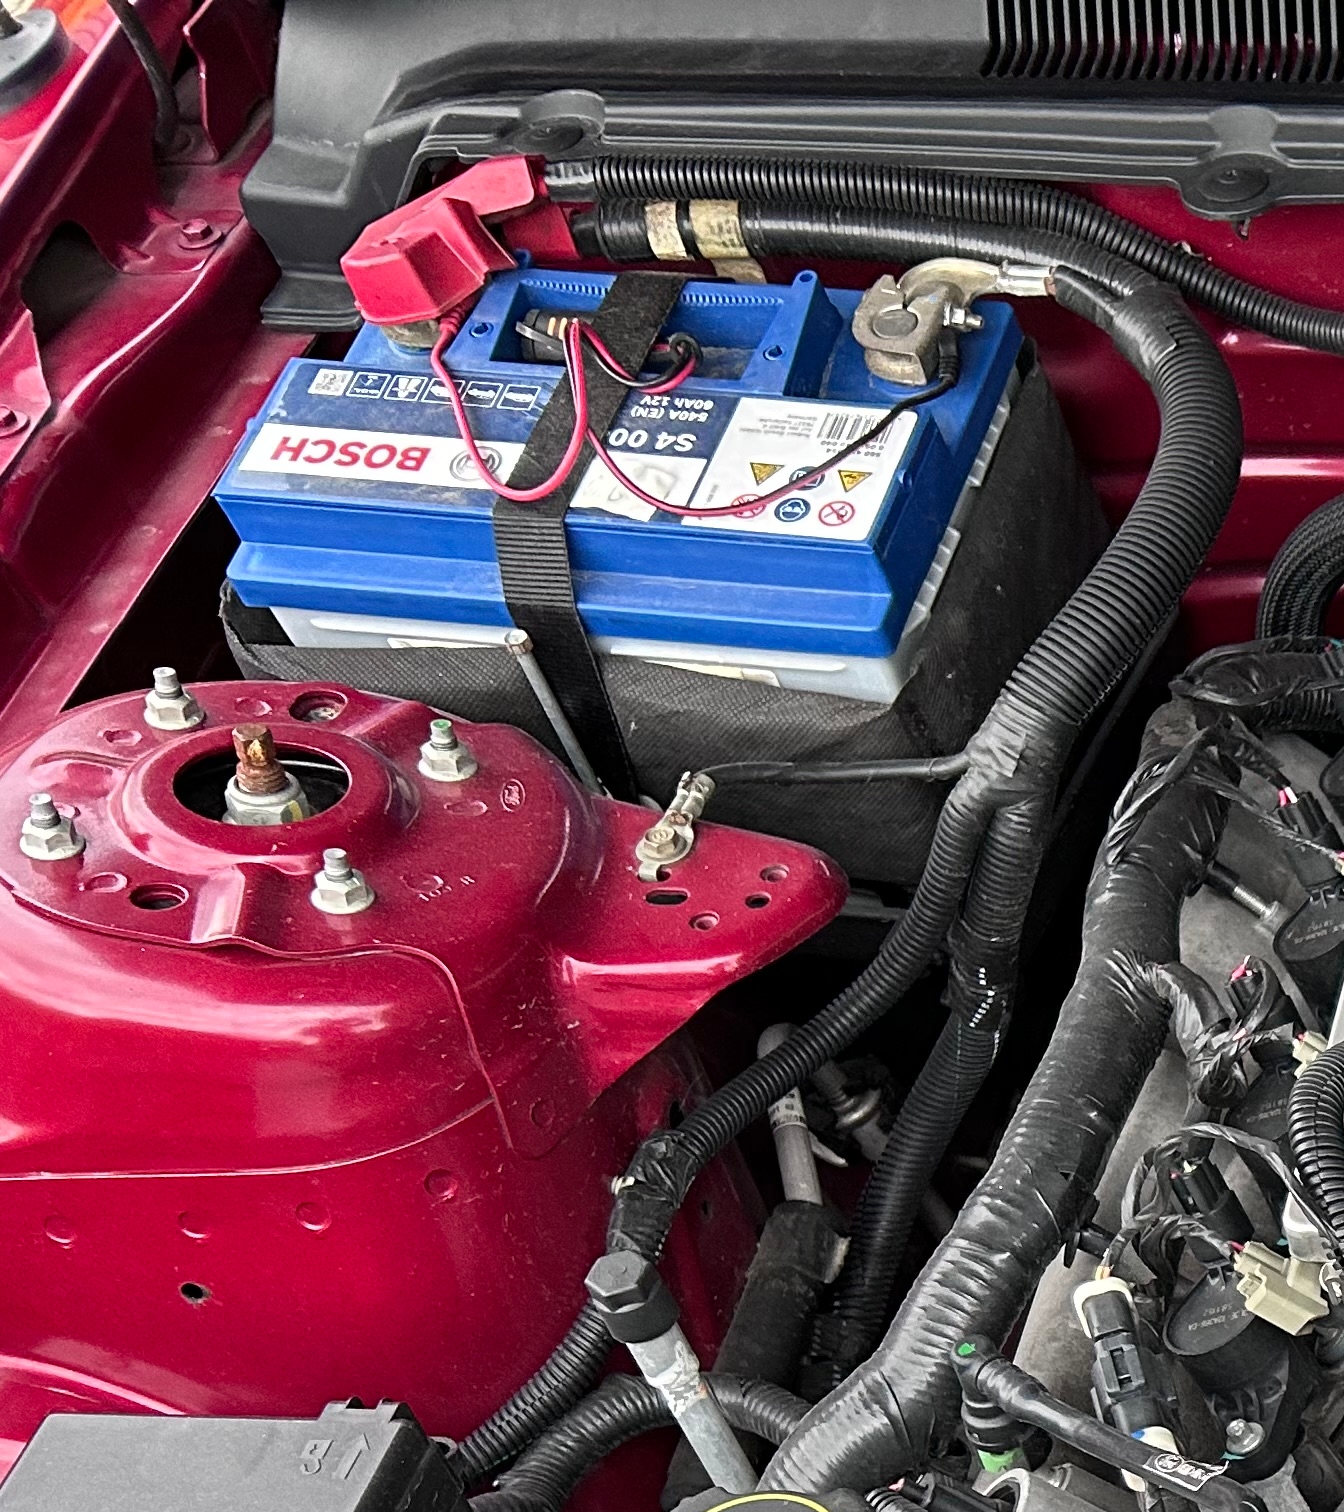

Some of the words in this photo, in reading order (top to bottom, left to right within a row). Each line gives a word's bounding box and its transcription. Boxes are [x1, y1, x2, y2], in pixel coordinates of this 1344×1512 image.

[639, 394, 672, 408] 12V
[673, 396, 716, 411] 60Ah
[630, 404, 667, 420] (EN)
[668, 408, 711, 423] 540A
[603, 427, 650, 449] 00
[657, 431, 698, 453] S4
[270, 434, 431, 474] BOSCH
